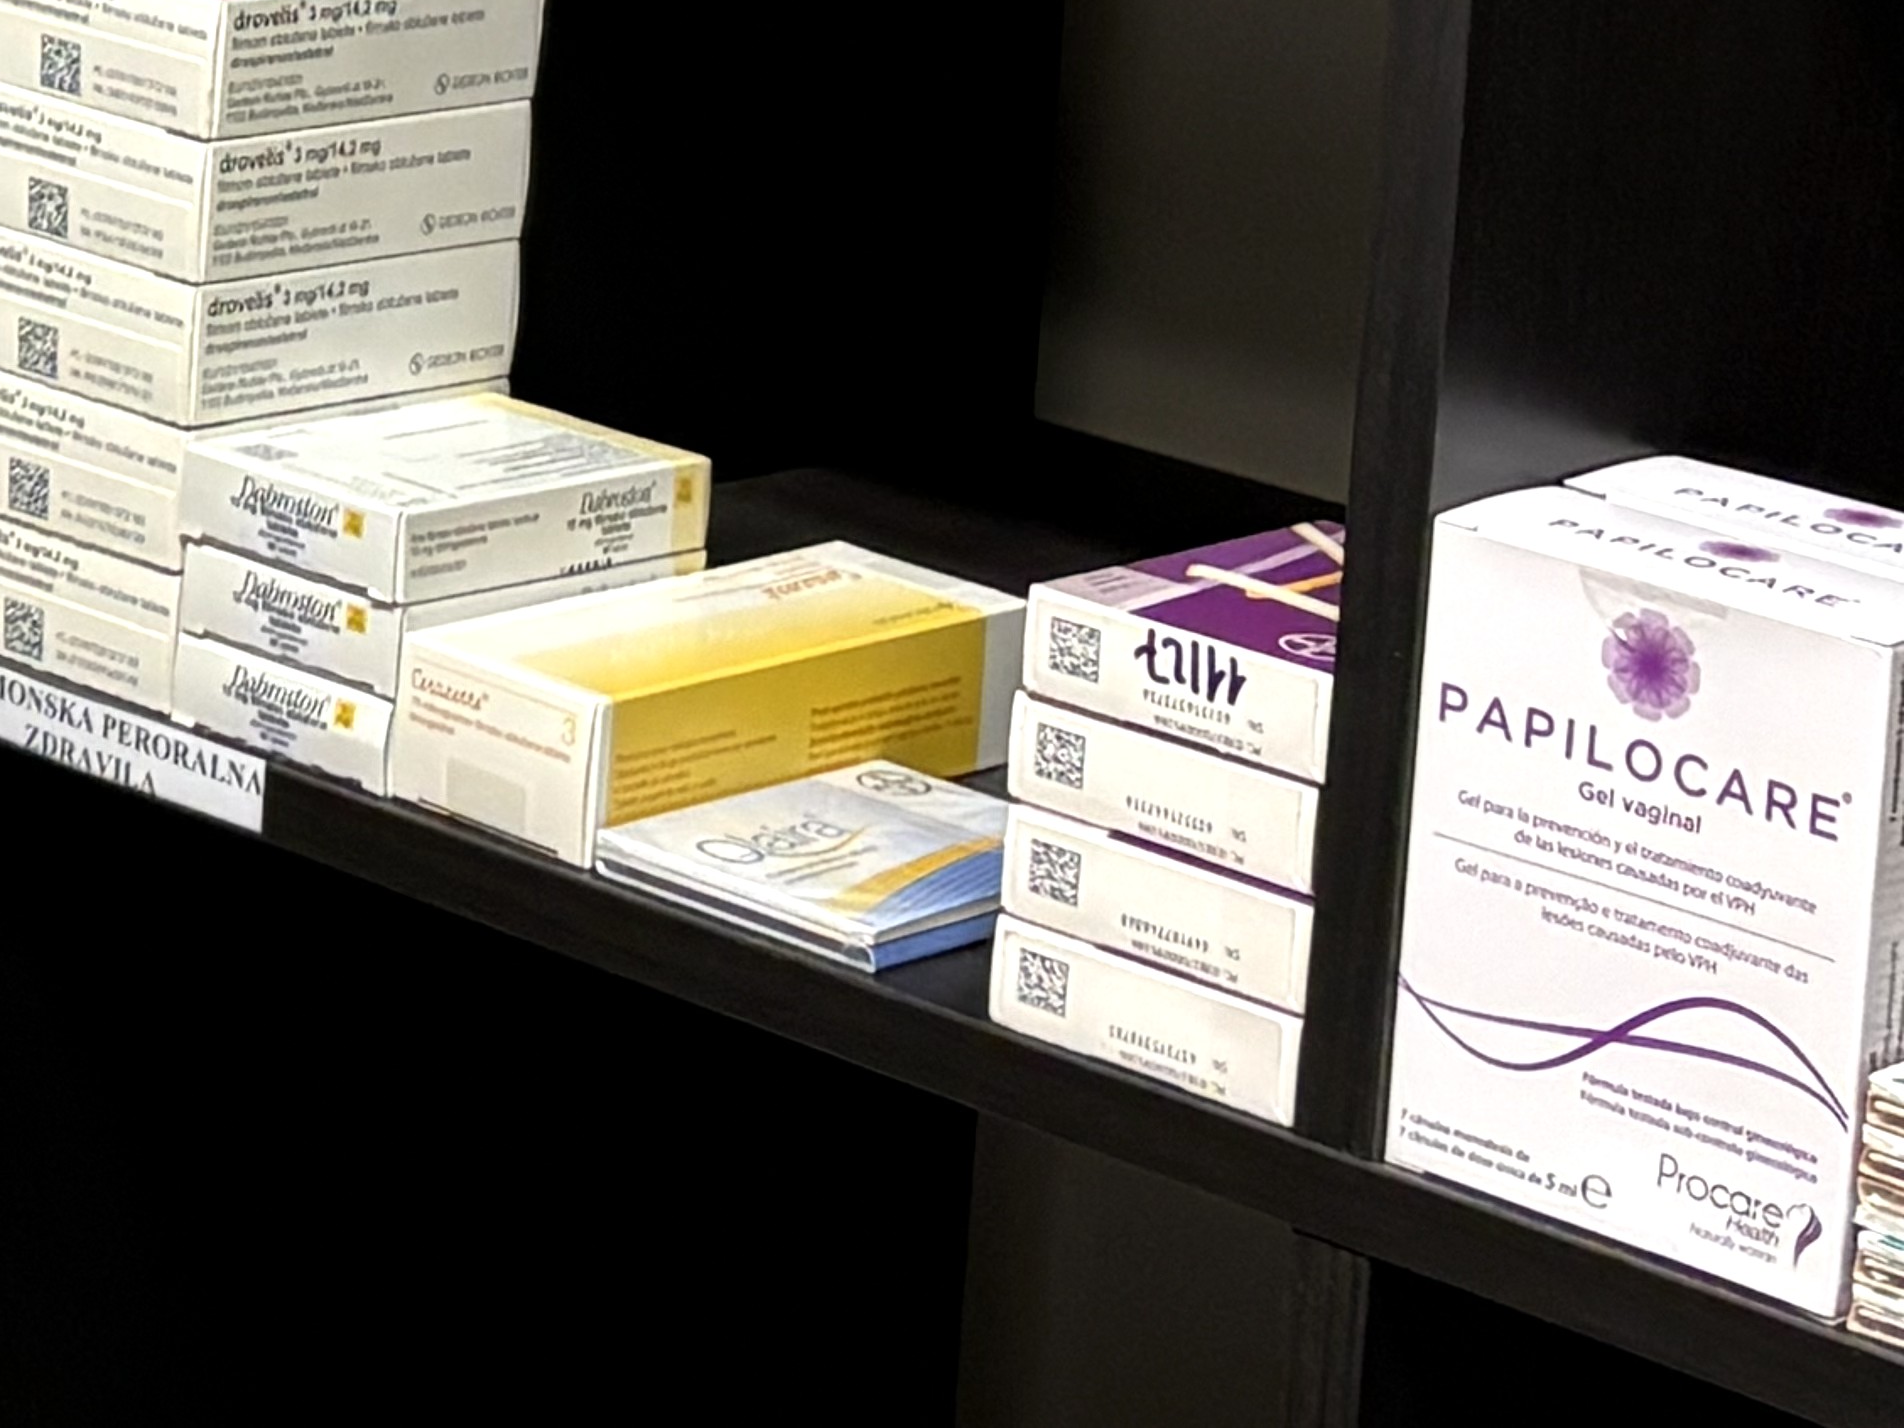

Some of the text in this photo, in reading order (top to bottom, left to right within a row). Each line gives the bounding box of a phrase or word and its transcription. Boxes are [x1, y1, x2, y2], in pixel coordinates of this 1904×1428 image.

[1548, 517, 1849, 607] PAPILOCARE
[24, 722, 158, 796] ZDRAVILA
[101, 713, 263, 796] PERORALNA
[1438, 681, 1840, 842] PAPILOCARE
[1458, 790, 1482, 809] Gel
[1483, 800, 1515, 821] para
[1578, 781, 1703, 835] Gel vaginal
[1454, 857, 1479, 878] Gel
[1657, 1153, 1784, 1229] Procare
